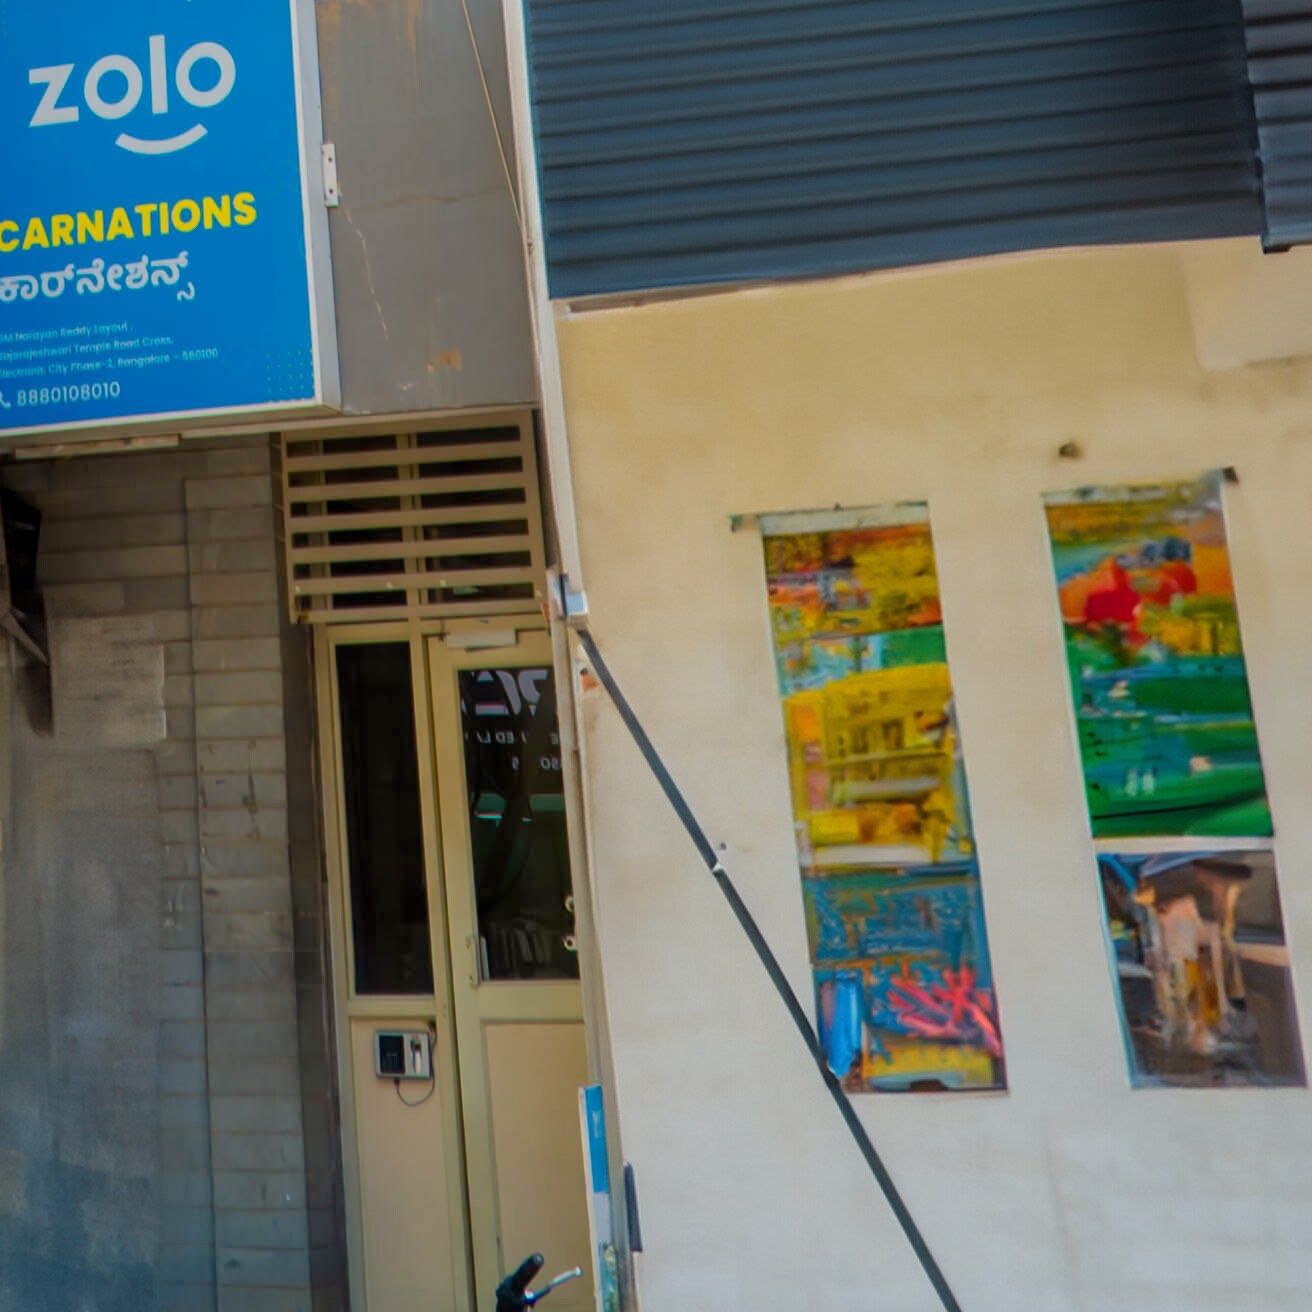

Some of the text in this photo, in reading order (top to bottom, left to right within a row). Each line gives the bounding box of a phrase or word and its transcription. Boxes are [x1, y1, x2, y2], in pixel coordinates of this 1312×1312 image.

[29, 34, 237, 128] zolo
[60, 326, 92, 337] Reddy
[75, 340, 112, 354] Temple
[48, 362, 68, 376] City
[16, 380, 121, 407] 8880108010
